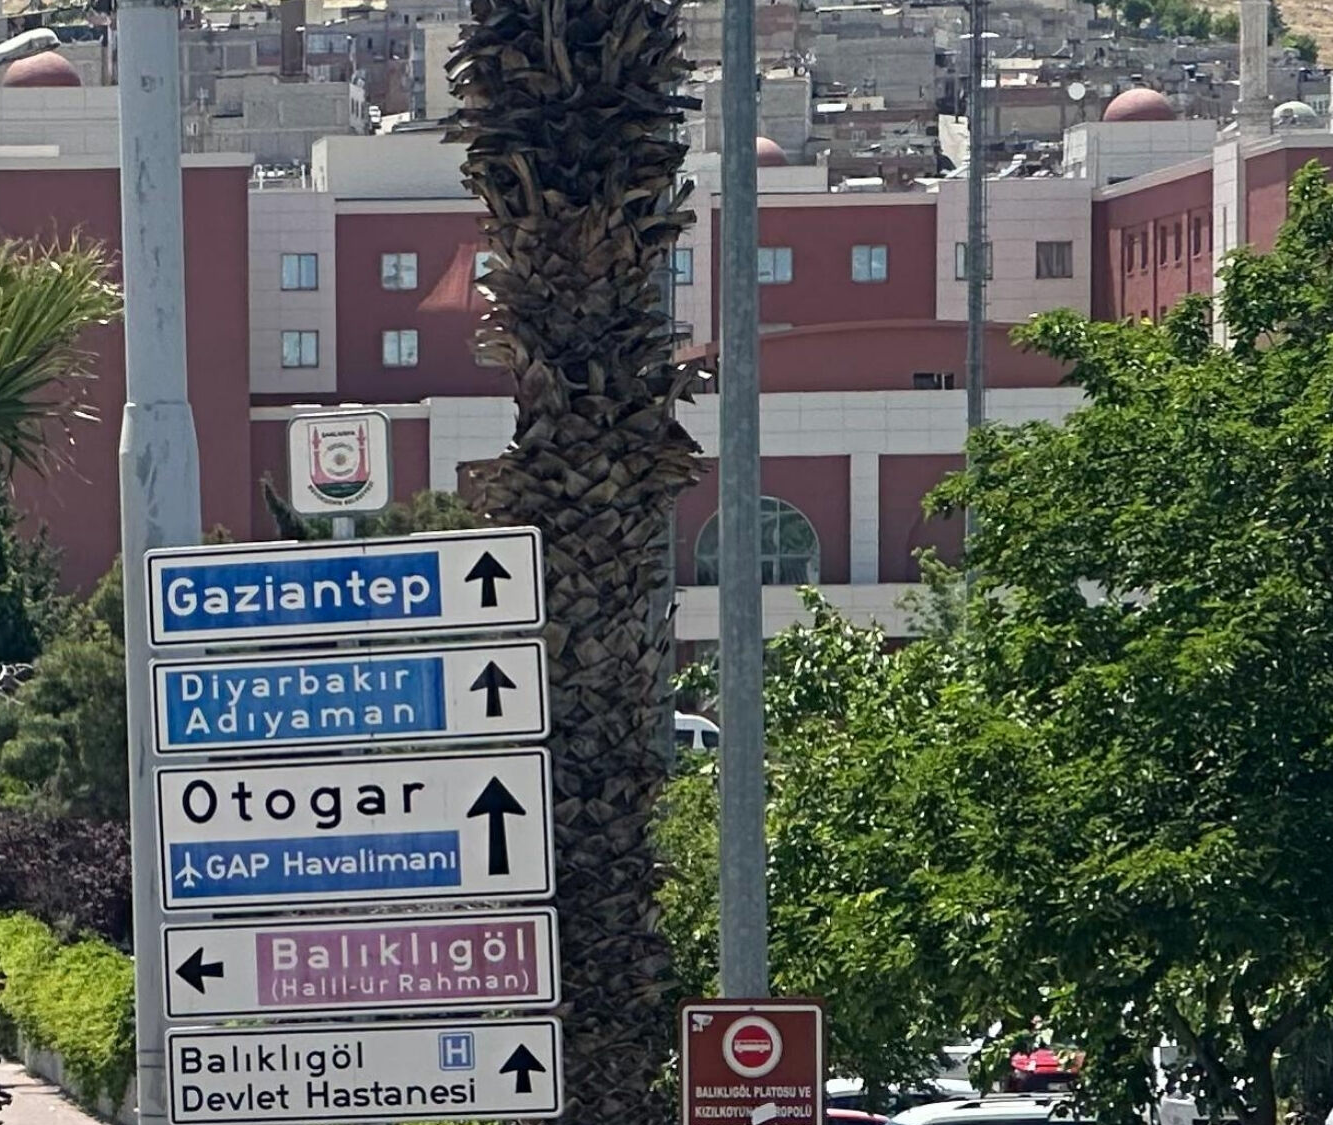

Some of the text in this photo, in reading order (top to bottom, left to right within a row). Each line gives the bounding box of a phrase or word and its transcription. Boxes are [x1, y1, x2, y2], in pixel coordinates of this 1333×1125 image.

[166, 570, 431, 618] Gaziantep
[181, 664, 410, 707] Diyarbakır
[185, 701, 415, 738] Adıyaman
[182, 779, 425, 829] Otogar
[206, 848, 456, 880] GAP Havalimanı
[271, 928, 525, 971] Balıklıgöl
[398, 970, 530, 993] Rahman)
[180, 1041, 363, 1077] Balıklıgöl
[182, 1078, 476, 1112] Devlet Hastanesi
[695, 1085, 812, 1098] BALIKLIGÖL PLATOSU VE
